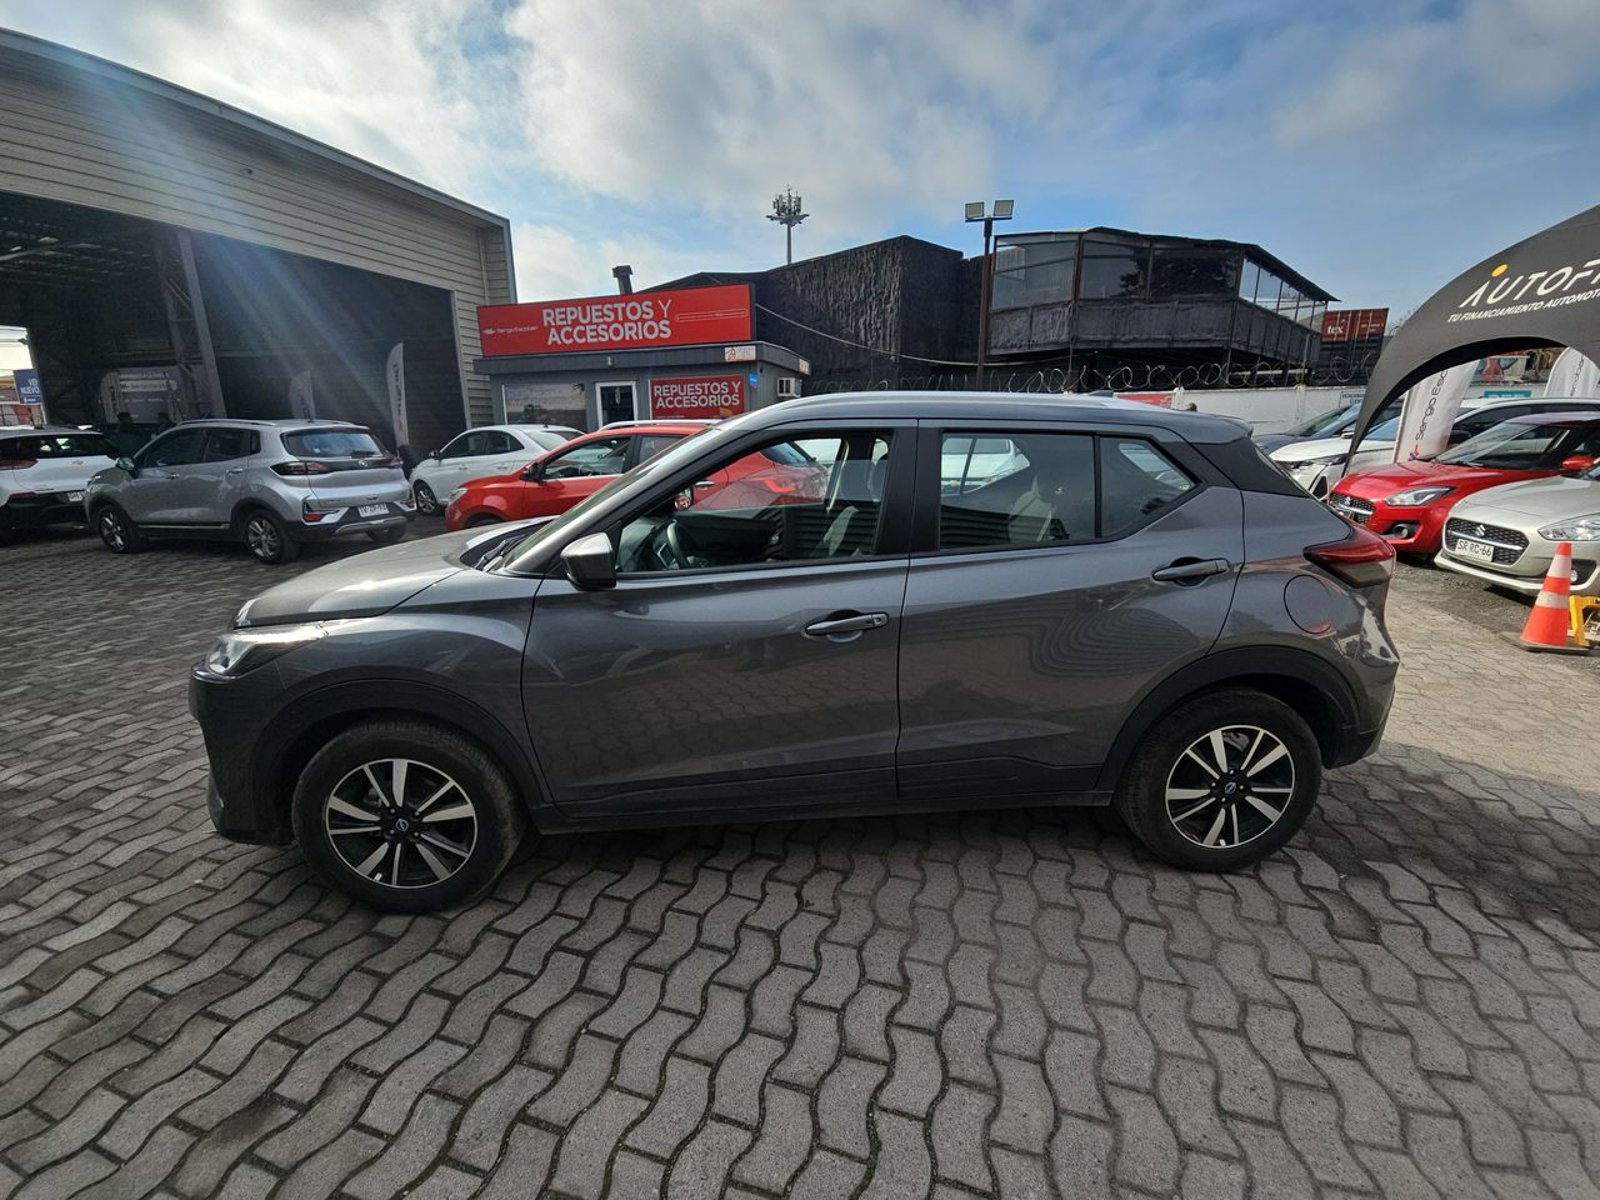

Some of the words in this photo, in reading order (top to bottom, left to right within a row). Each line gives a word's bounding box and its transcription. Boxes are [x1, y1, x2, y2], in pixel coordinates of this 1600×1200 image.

[542, 301, 655, 327] REPUESTOS
[658, 299, 672, 318] Y
[1447, 313, 1462, 323] TU
[1460, 301, 1544, 321] FINANCIAMIENTO
[547, 319, 672, 345] ACCESORIOS
[654, 382, 729, 397] REPUESTOS
[731, 381, 741, 393] Y
[656, 394, 740, 409] ACCESORIOS
